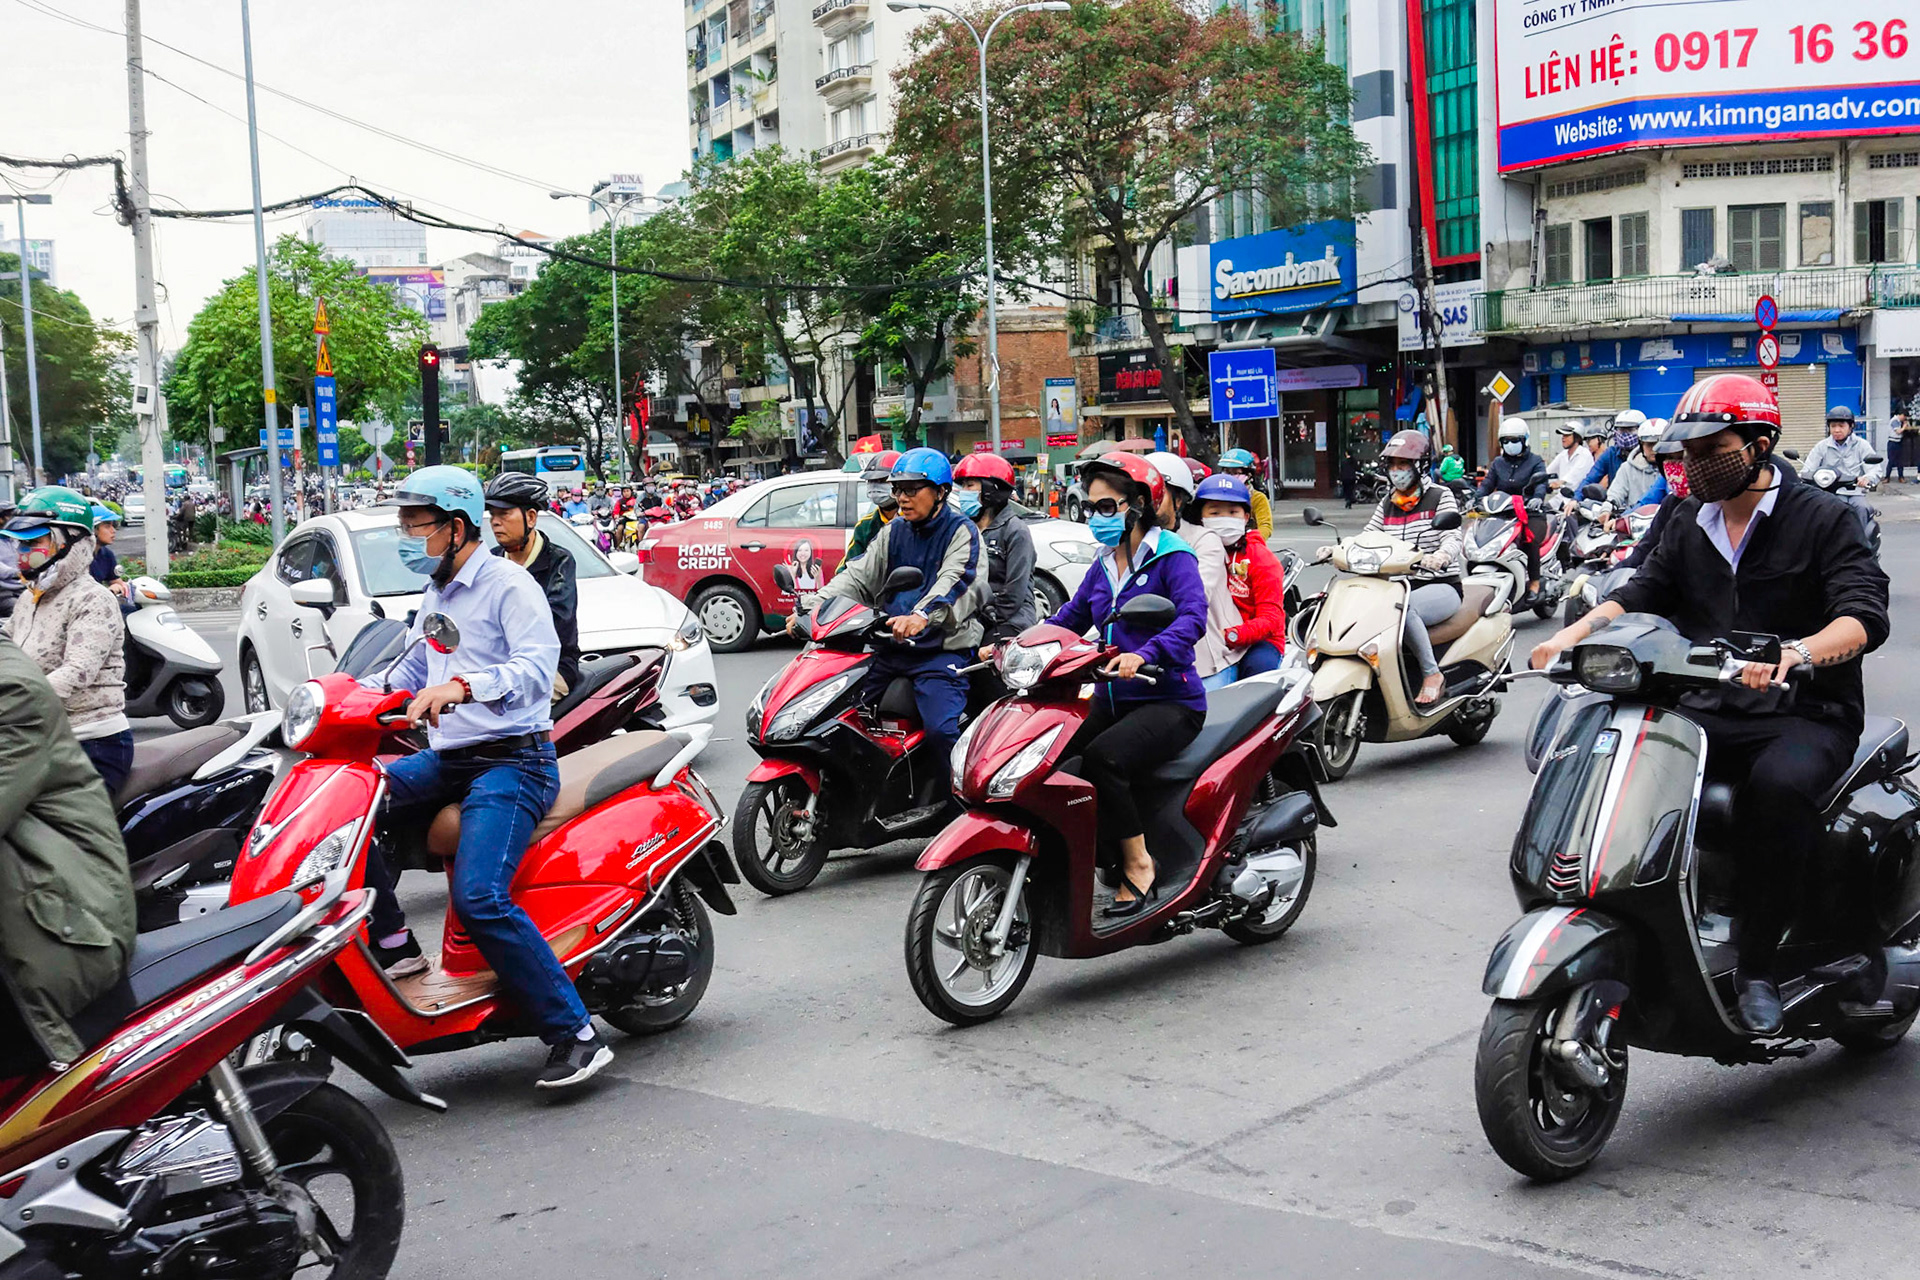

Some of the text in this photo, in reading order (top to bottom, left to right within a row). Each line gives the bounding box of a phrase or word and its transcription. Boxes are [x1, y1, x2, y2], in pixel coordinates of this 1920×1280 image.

[1523, 10, 1557, 29] CÔNG
[1560, 3, 1577, 19] TY
[1524, 18, 1909, 99] LIÊN HỆ: 0917 16 36
[1554, 115, 1623, 146] Website:
[1214, 245, 1341, 299] Sacombank
[1218, 479, 1233, 489] ila
[703, 520, 724, 530] 5485
[678, 544, 726, 556] HOME
[677, 557, 732, 570] CREDIT
[821, 725, 840, 738] HONDA
[214, 774, 254, 793] LEAD
[1067, 795, 1093, 806] HONDA
